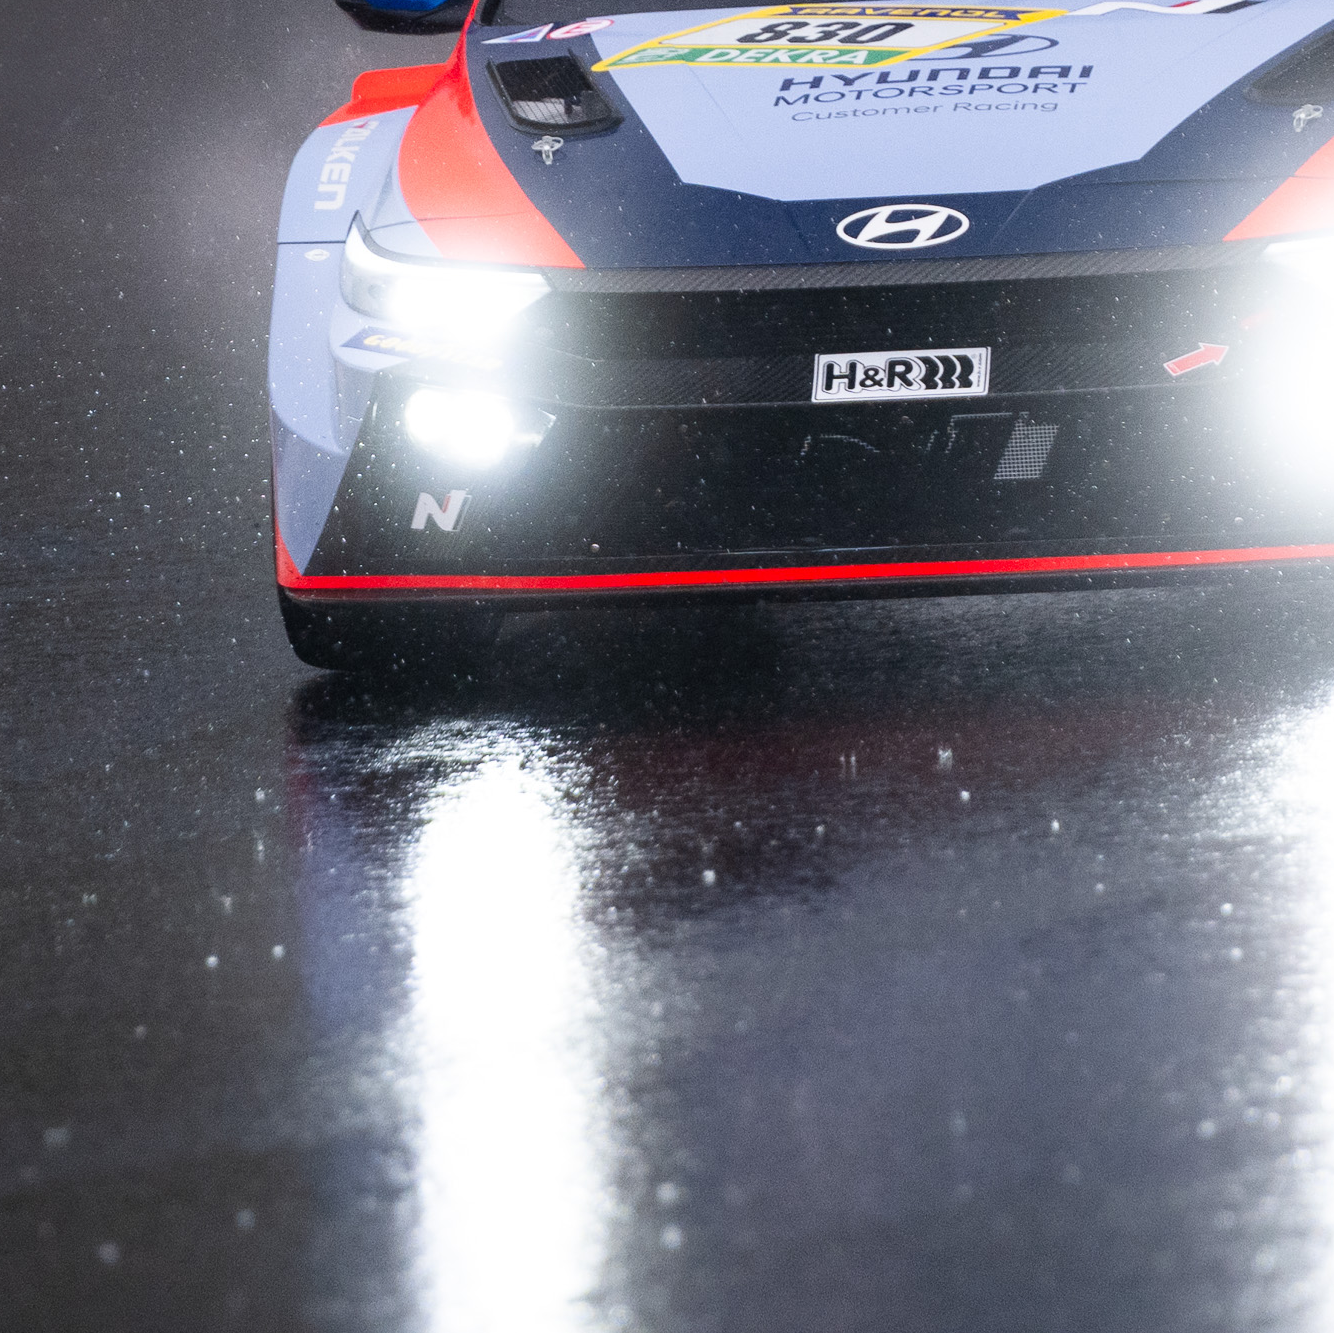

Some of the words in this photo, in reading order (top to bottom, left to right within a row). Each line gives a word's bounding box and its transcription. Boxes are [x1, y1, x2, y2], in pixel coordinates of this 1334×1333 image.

[796, 7, 1008, 19] RAVENOL
[736, 21, 916, 45] 830
[694, 48, 870, 66] DEKRA
[779, 65, 1095, 93] HYUNDAI
[773, 82, 1088, 108] MOTORSPORT
[790, 102, 945, 122] Customer
[952, 100, 1060, 114] Racing
[823, 358, 917, 393] H&R
